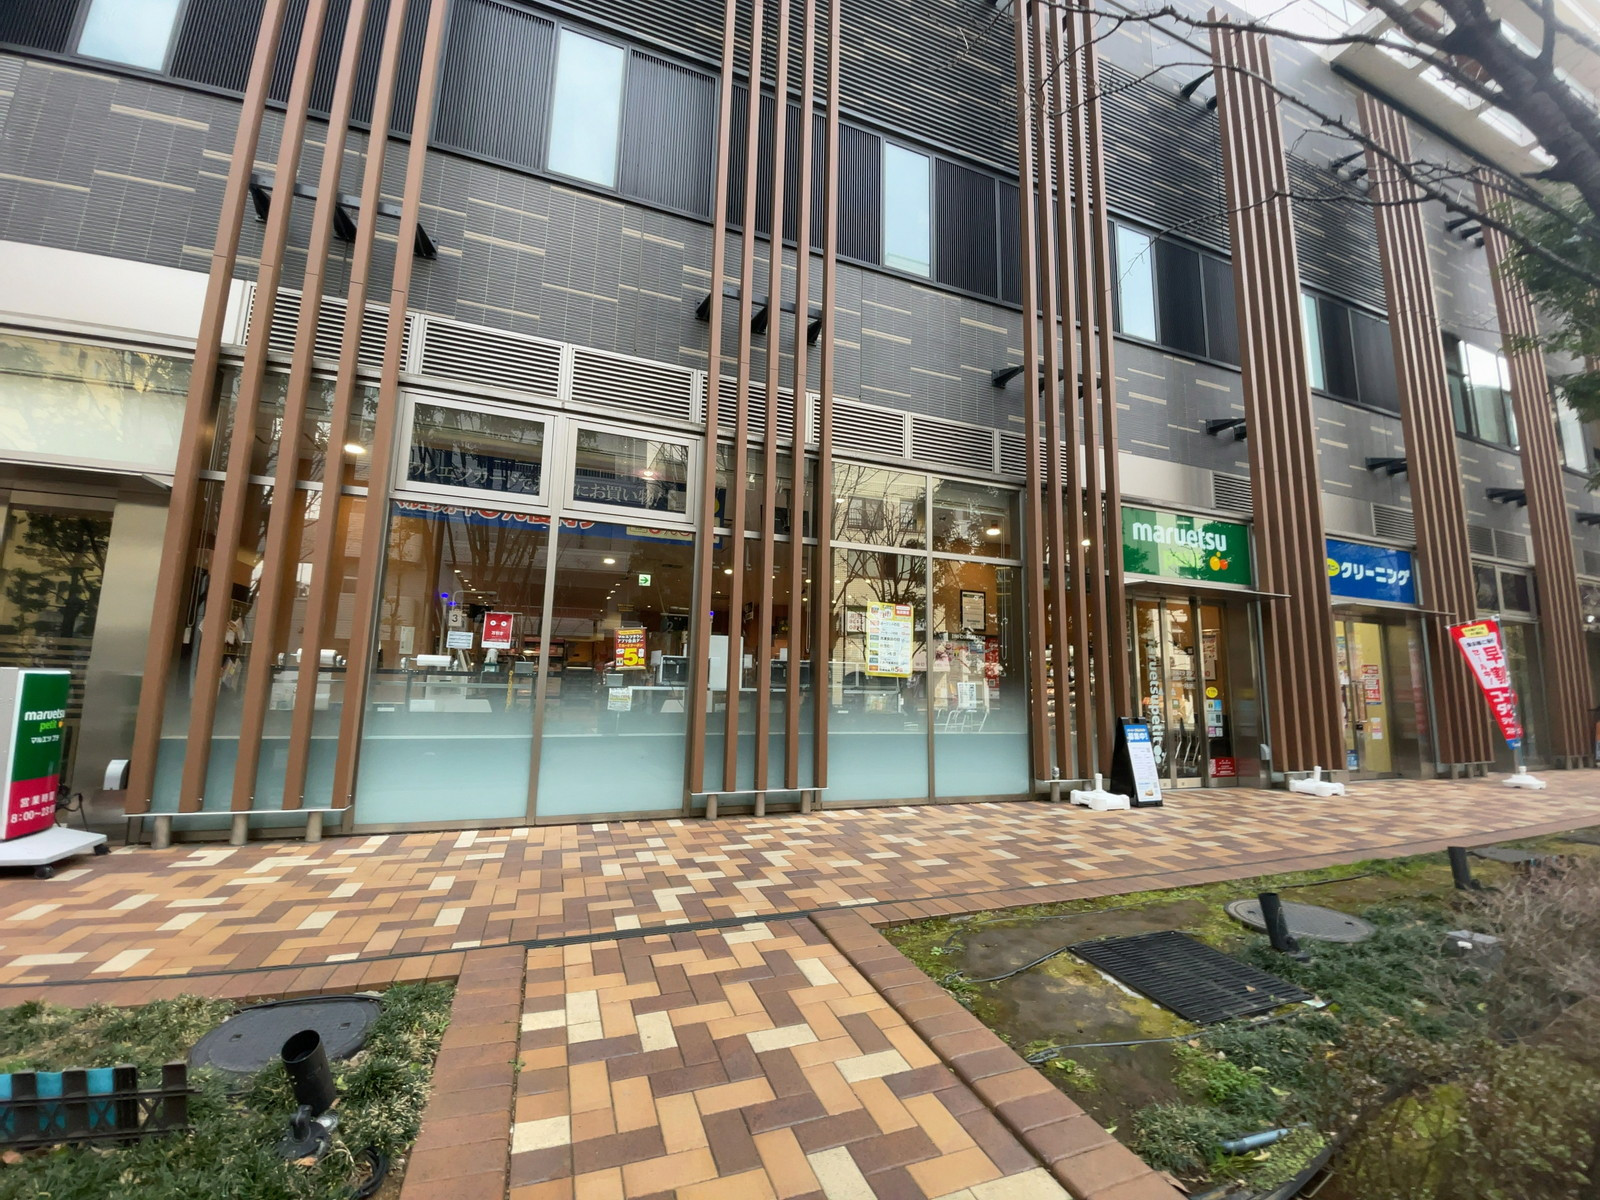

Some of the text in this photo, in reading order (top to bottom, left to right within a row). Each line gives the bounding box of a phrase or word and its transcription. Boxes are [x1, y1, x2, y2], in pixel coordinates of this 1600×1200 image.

[1132, 522, 1227, 552] maruetsu
[1341, 562, 1410, 586] クリーニング
[451, 614, 458, 623] 3
